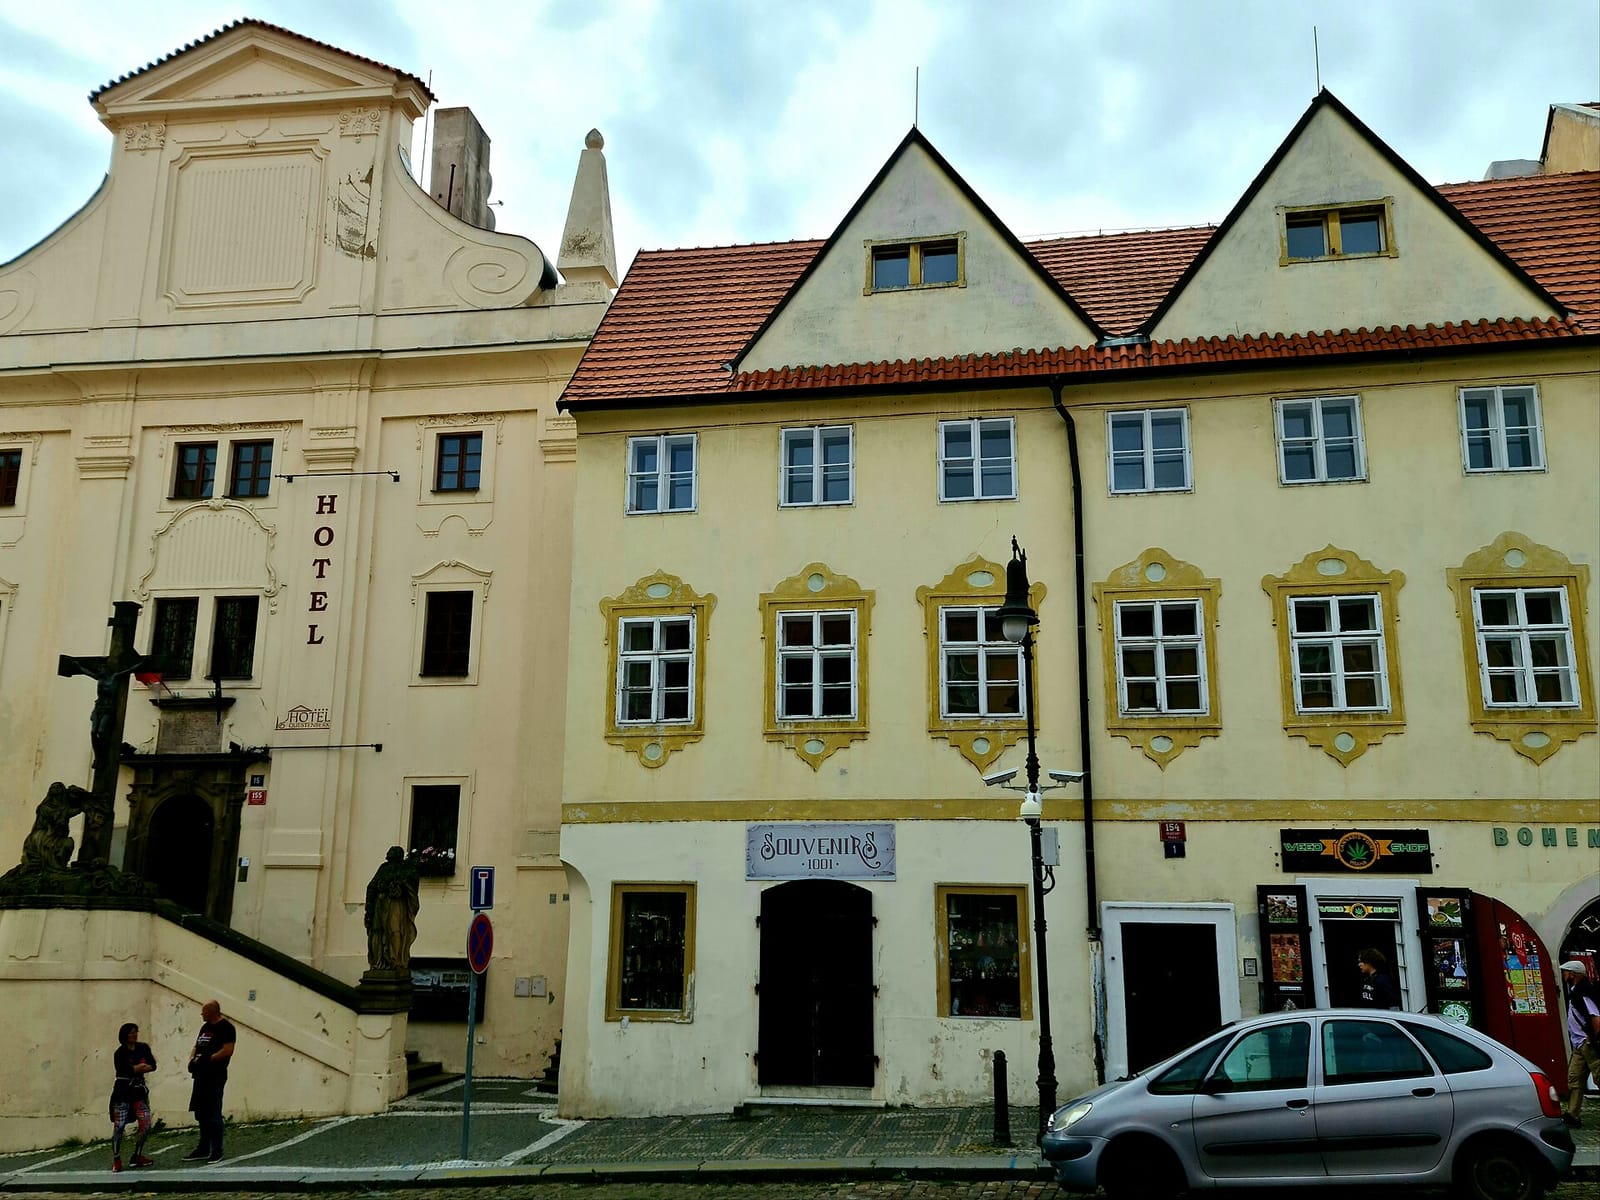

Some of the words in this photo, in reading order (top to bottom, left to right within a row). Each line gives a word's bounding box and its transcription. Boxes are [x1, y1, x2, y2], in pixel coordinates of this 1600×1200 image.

[307, 494, 338, 645] HOTEL
[289, 711, 331, 723] HOTEL
[251, 791, 263, 799] 155
[1165, 823, 1181, 832] 154
[760, 831, 882, 870] SOUVENIRS
[1283, 842, 1324, 852] WEED
[1390, 843, 1429, 853] SHOP
[807, 858, 834, 870] 1001
